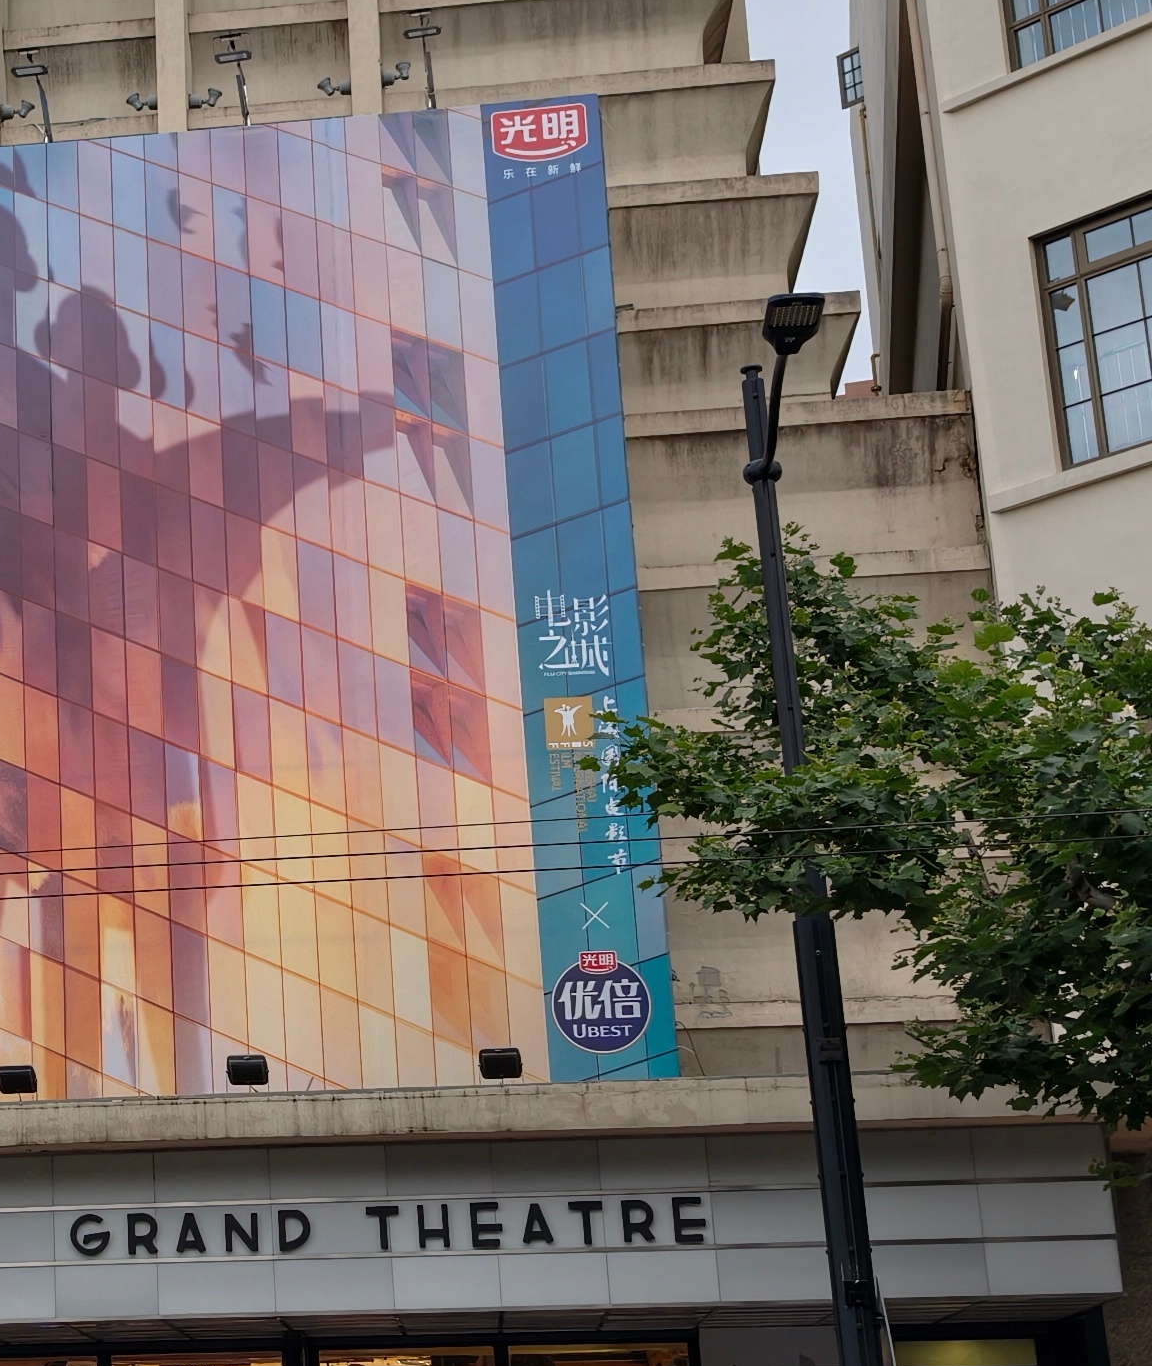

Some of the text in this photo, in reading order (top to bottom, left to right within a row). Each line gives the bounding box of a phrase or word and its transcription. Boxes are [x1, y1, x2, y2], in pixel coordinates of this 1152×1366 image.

[499, 108, 581, 146] 光明
[503, 162, 583, 180] 乐在新鲜
[582, 953, 614, 967] 光明
[557, 978, 642, 1021] 优倍
[572, 1023, 634, 1039] UBEST
[69, 1196, 707, 1256] GRAND THEATRE
